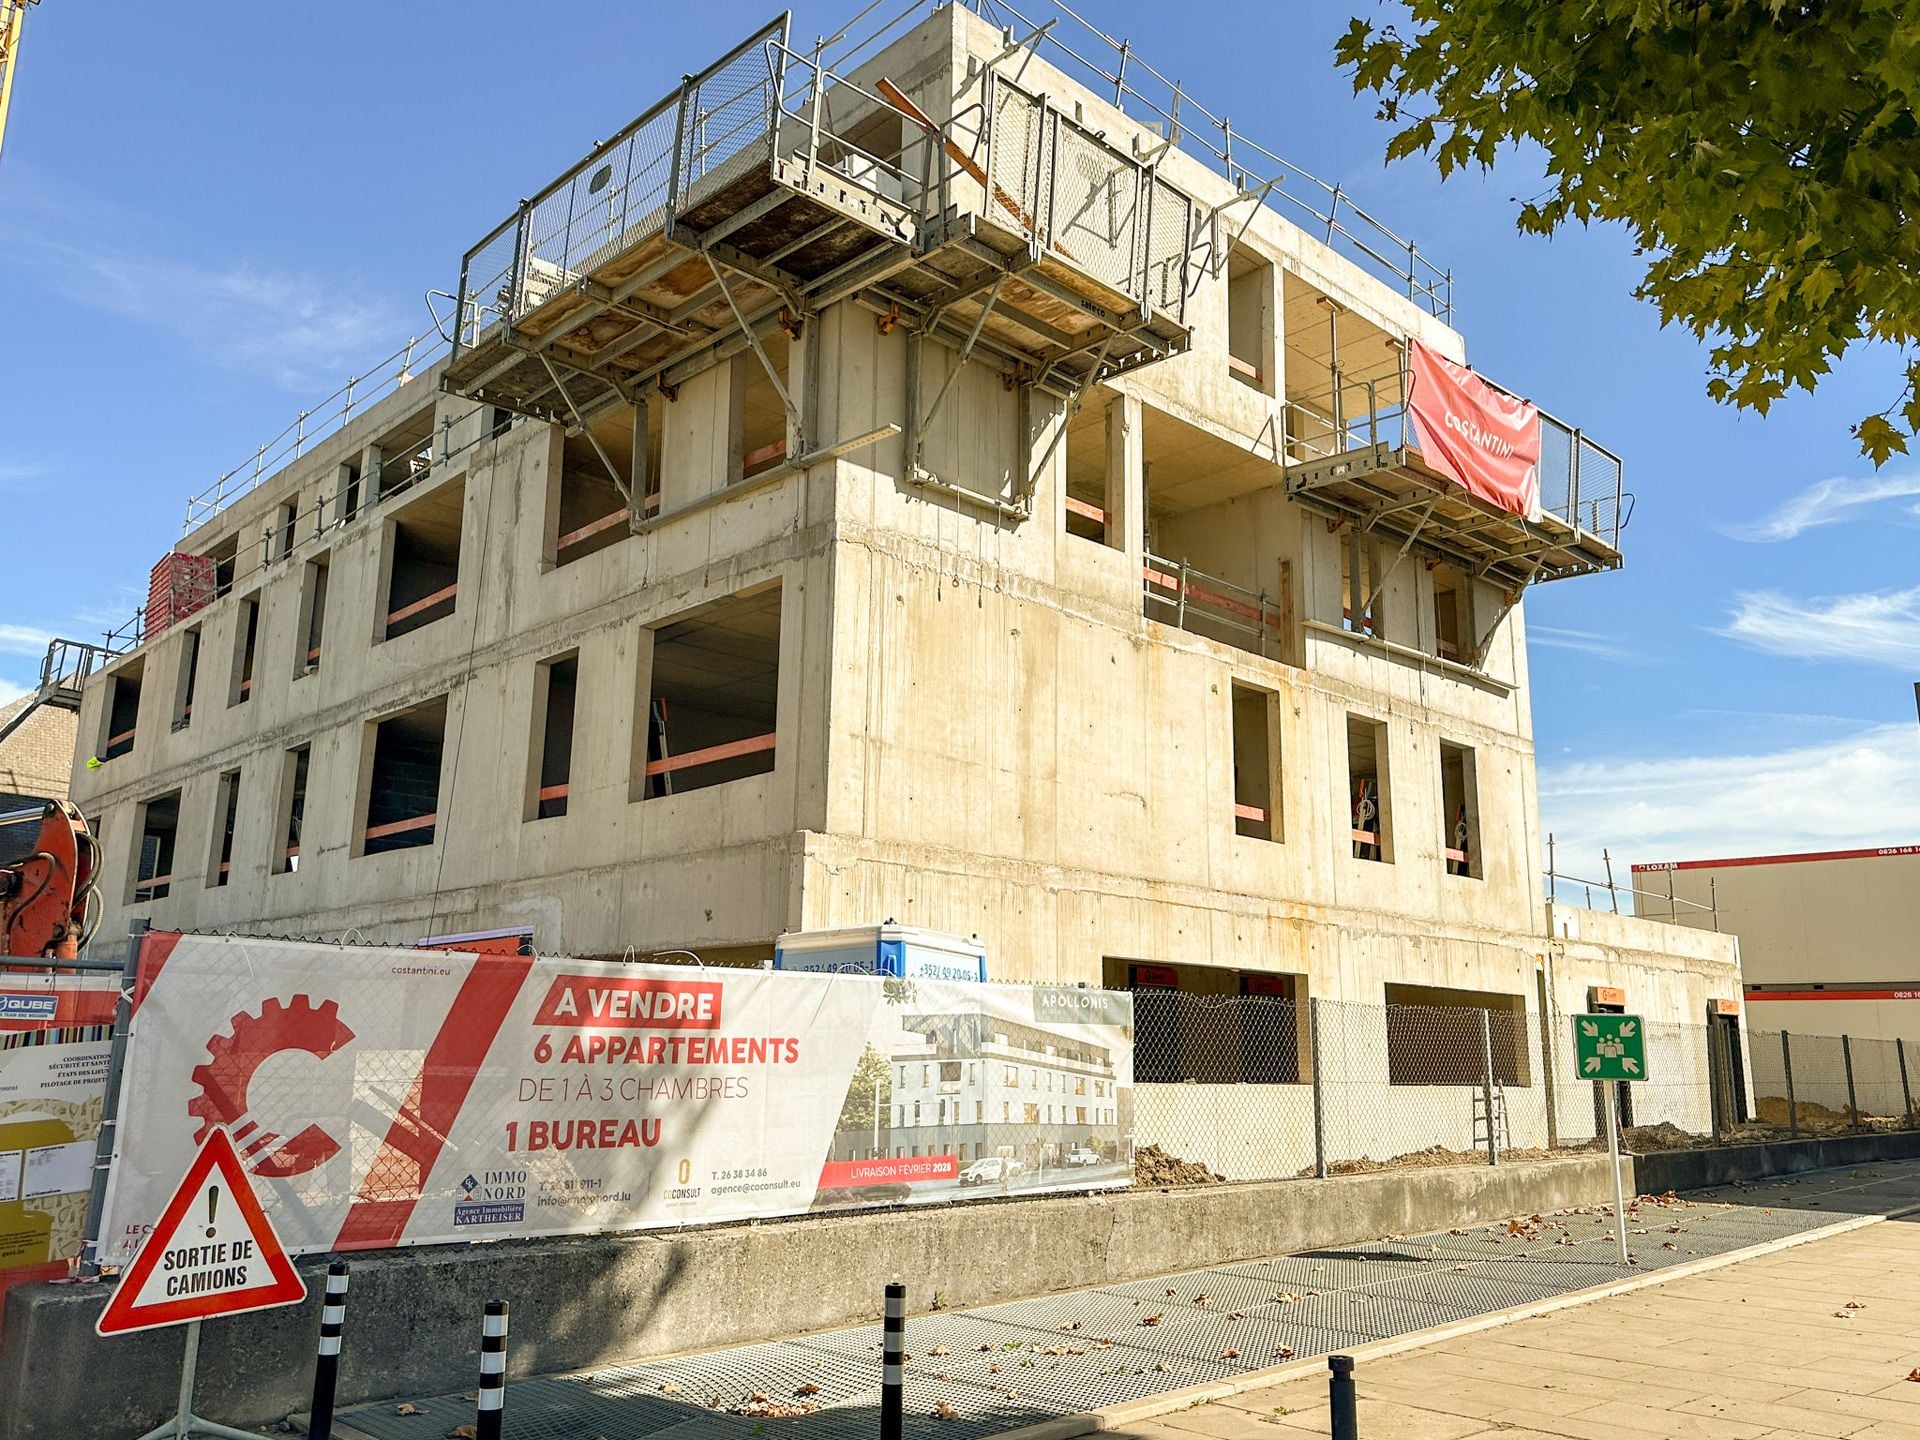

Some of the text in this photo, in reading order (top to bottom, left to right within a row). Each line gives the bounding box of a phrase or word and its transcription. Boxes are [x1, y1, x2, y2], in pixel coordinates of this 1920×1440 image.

[1081, 300, 1105, 317] sateco
[1445, 411, 1514, 460] COSTANTINI
[1646, 862, 1678, 871] LOXAM
[391, 965, 451, 976] costantini.eu
[8, 1000, 53, 1009] QUBE
[554, 987, 713, 1021] A VENDRE
[1041, 994, 1109, 1009] APOLLONIS
[533, 1034, 800, 1065] 6 APPARTEMENTS
[63, 1053, 112, 1063] COORDINATION
[40, 1080, 72, 1088] PILOTAGE
[518, 1073, 749, 1102] DE 1 À 3 CHAMBRES
[505, 1118, 662, 1152] 1 BUREAU
[485, 1171, 527, 1185] IMMO
[712, 1168, 768, 1180] T. 26 38 34 86
[851, 1166, 896, 1179] LIVRAISON
[898, 1163, 932, 1175] FÉVRIER
[484, 1187, 526, 1200] NORD
[710, 1179, 801, 1196] agence@coconsult.eu
[456, 1208, 480, 1216] Agence
[456, 1213, 521, 1224] KARTHEISER
[126, 1224, 140, 1234] LE
[163, 1243, 227, 1271] SORTIE
[232, 1240, 253, 1261] DE
[166, 1265, 248, 1297] CAMIONS
